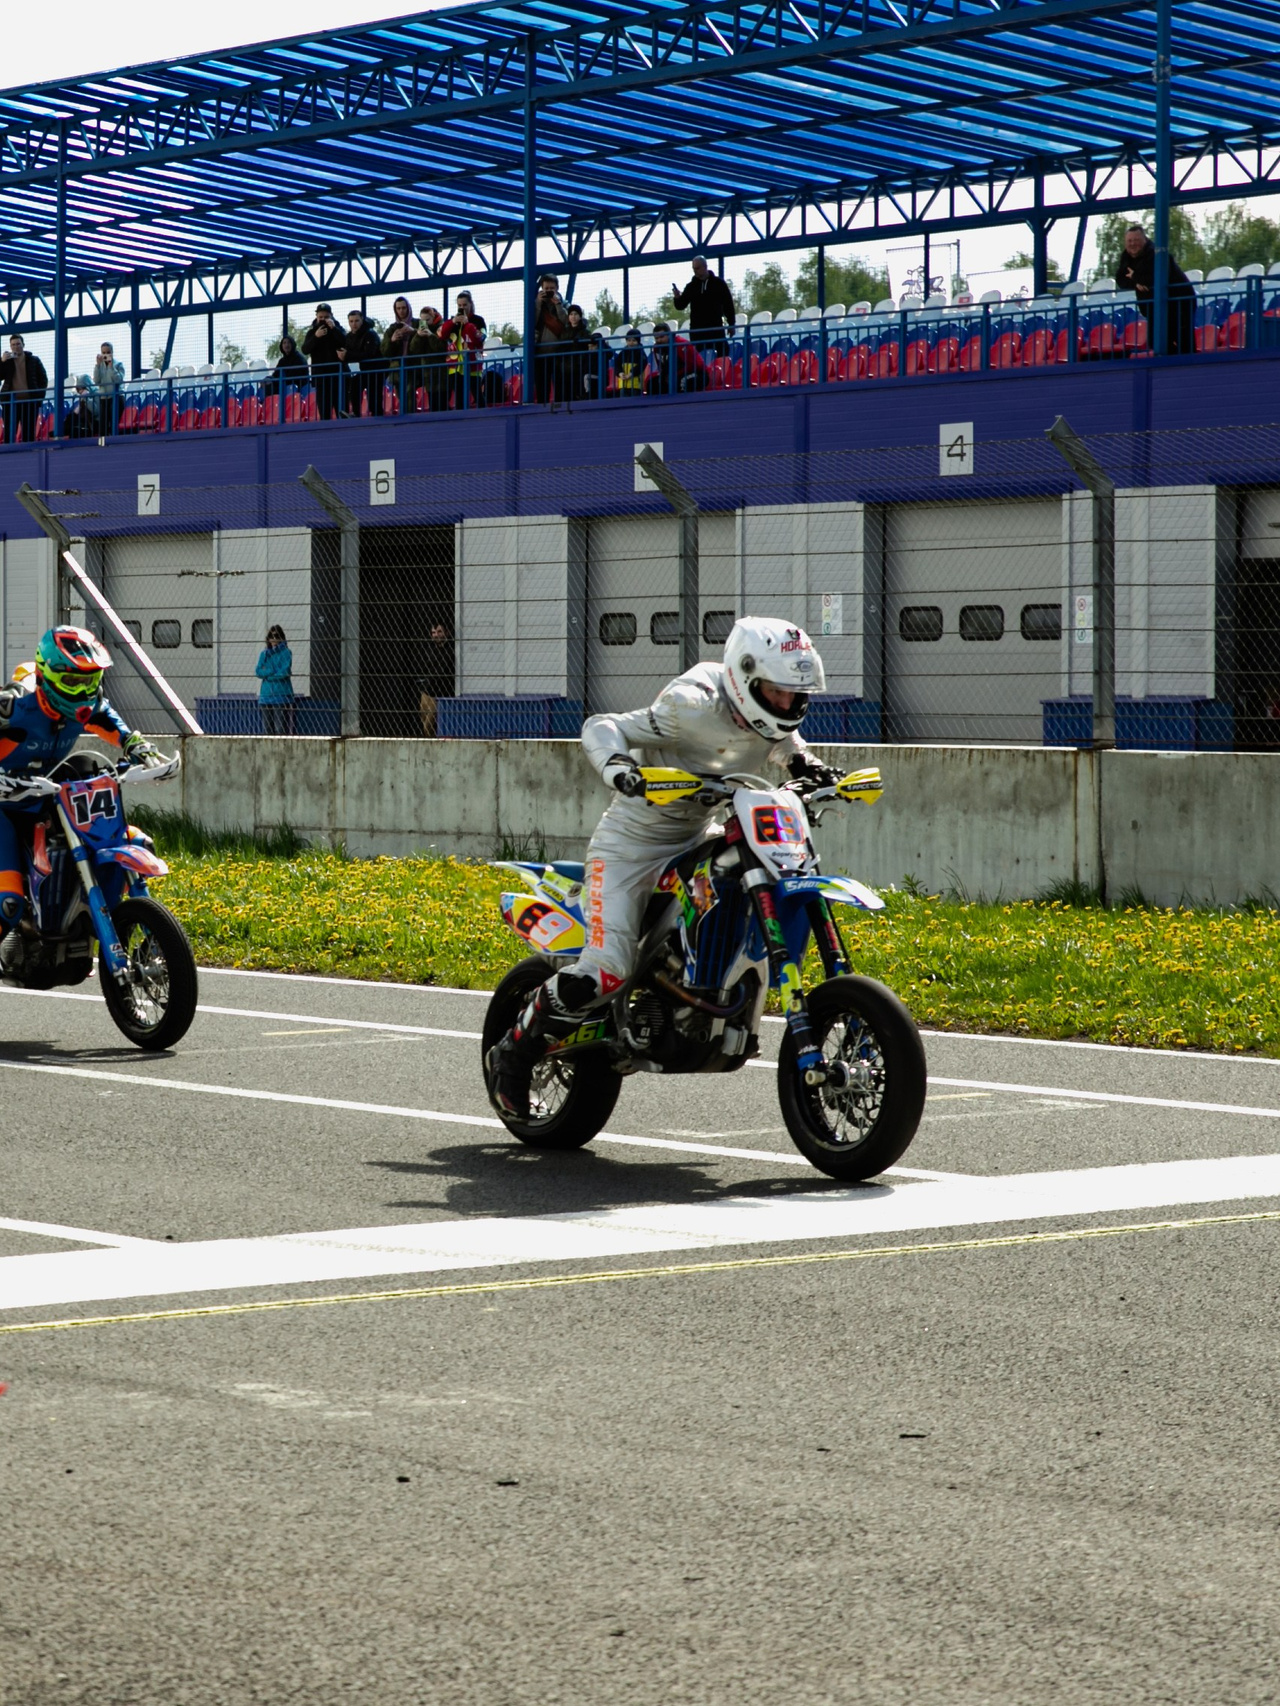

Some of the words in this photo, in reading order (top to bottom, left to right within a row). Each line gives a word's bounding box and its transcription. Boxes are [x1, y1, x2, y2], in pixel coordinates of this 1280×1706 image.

[946, 434, 966, 462] 4
[142, 484, 156, 507] 7
[375, 470, 390, 494] 6
[70, 787, 117, 826] 14
[752, 805, 807, 845] 69
[786, 880, 819, 892] SHOT
[516, 902, 575, 947] 69
